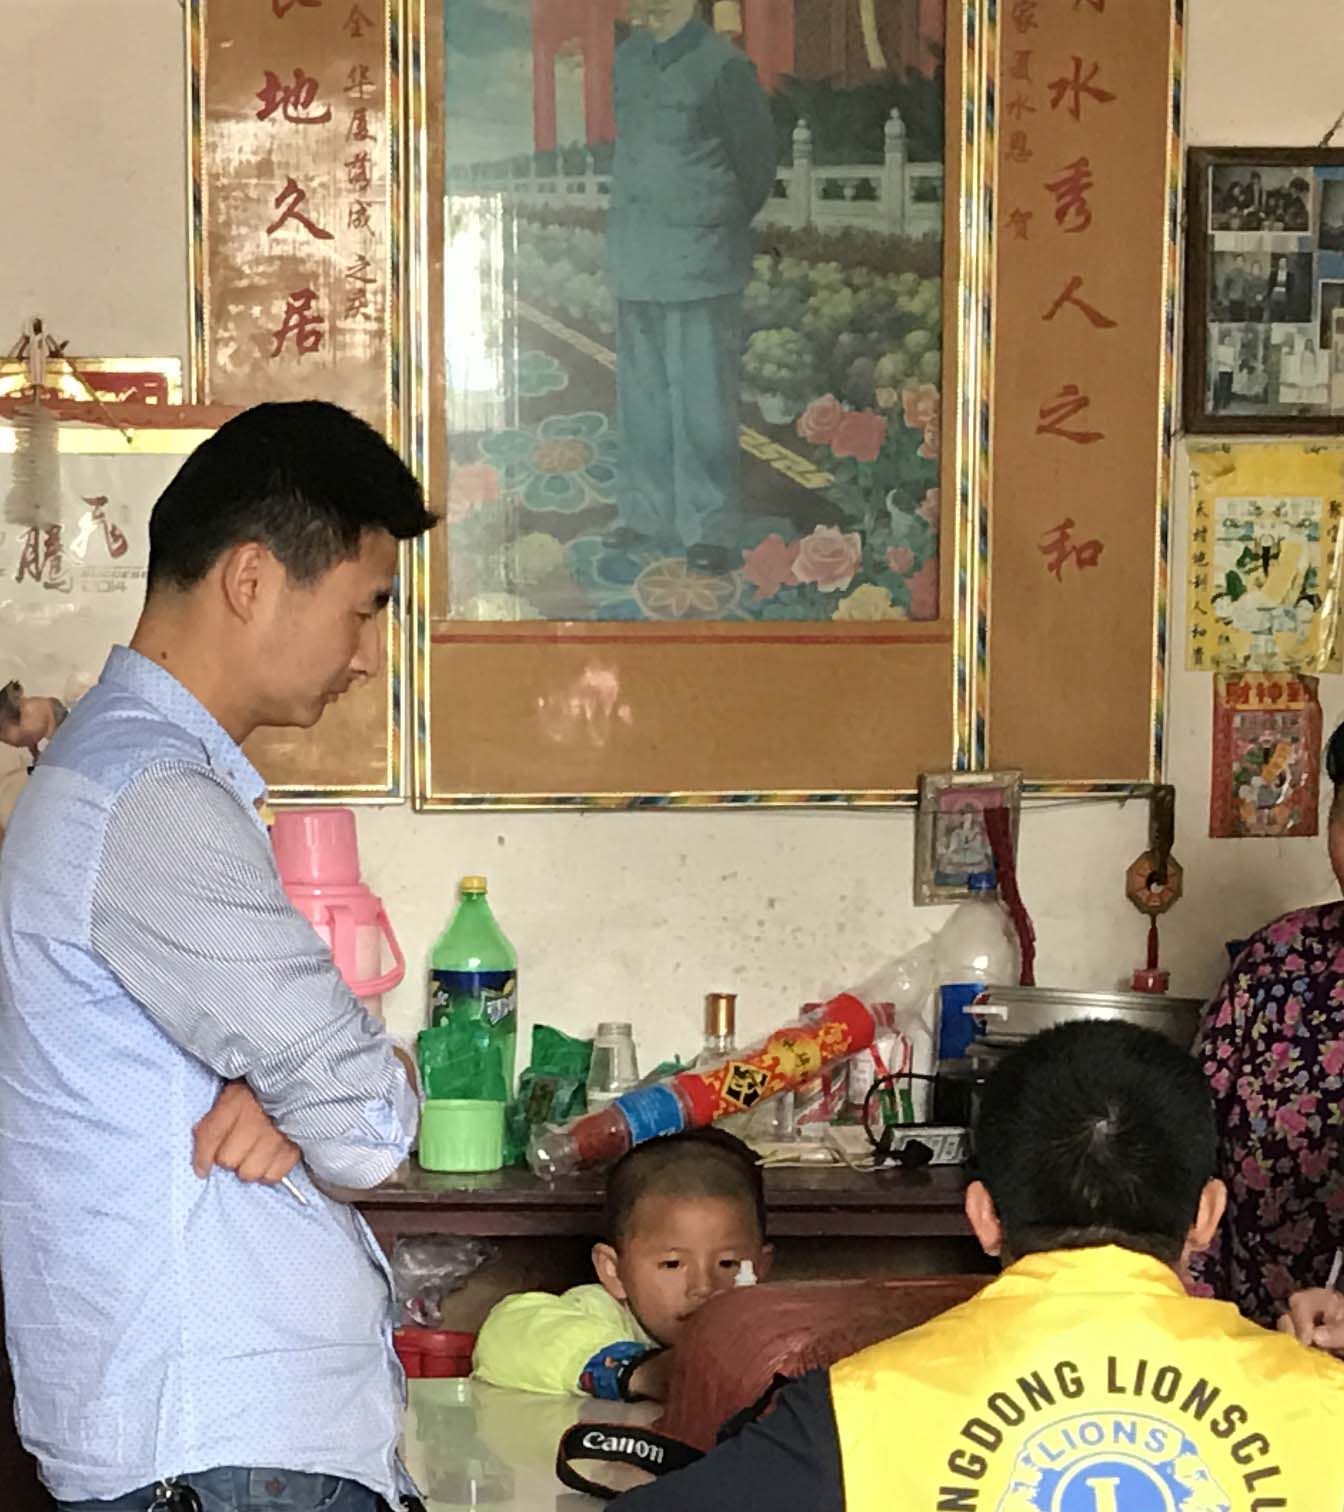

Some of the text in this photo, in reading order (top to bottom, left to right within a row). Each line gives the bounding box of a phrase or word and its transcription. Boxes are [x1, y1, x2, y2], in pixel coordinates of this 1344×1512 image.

[1036, 0, 1118, 583] 水秀人之和
[582, 1431, 665, 1464] Canon
[1038, 1421, 1169, 1463] LIONS
